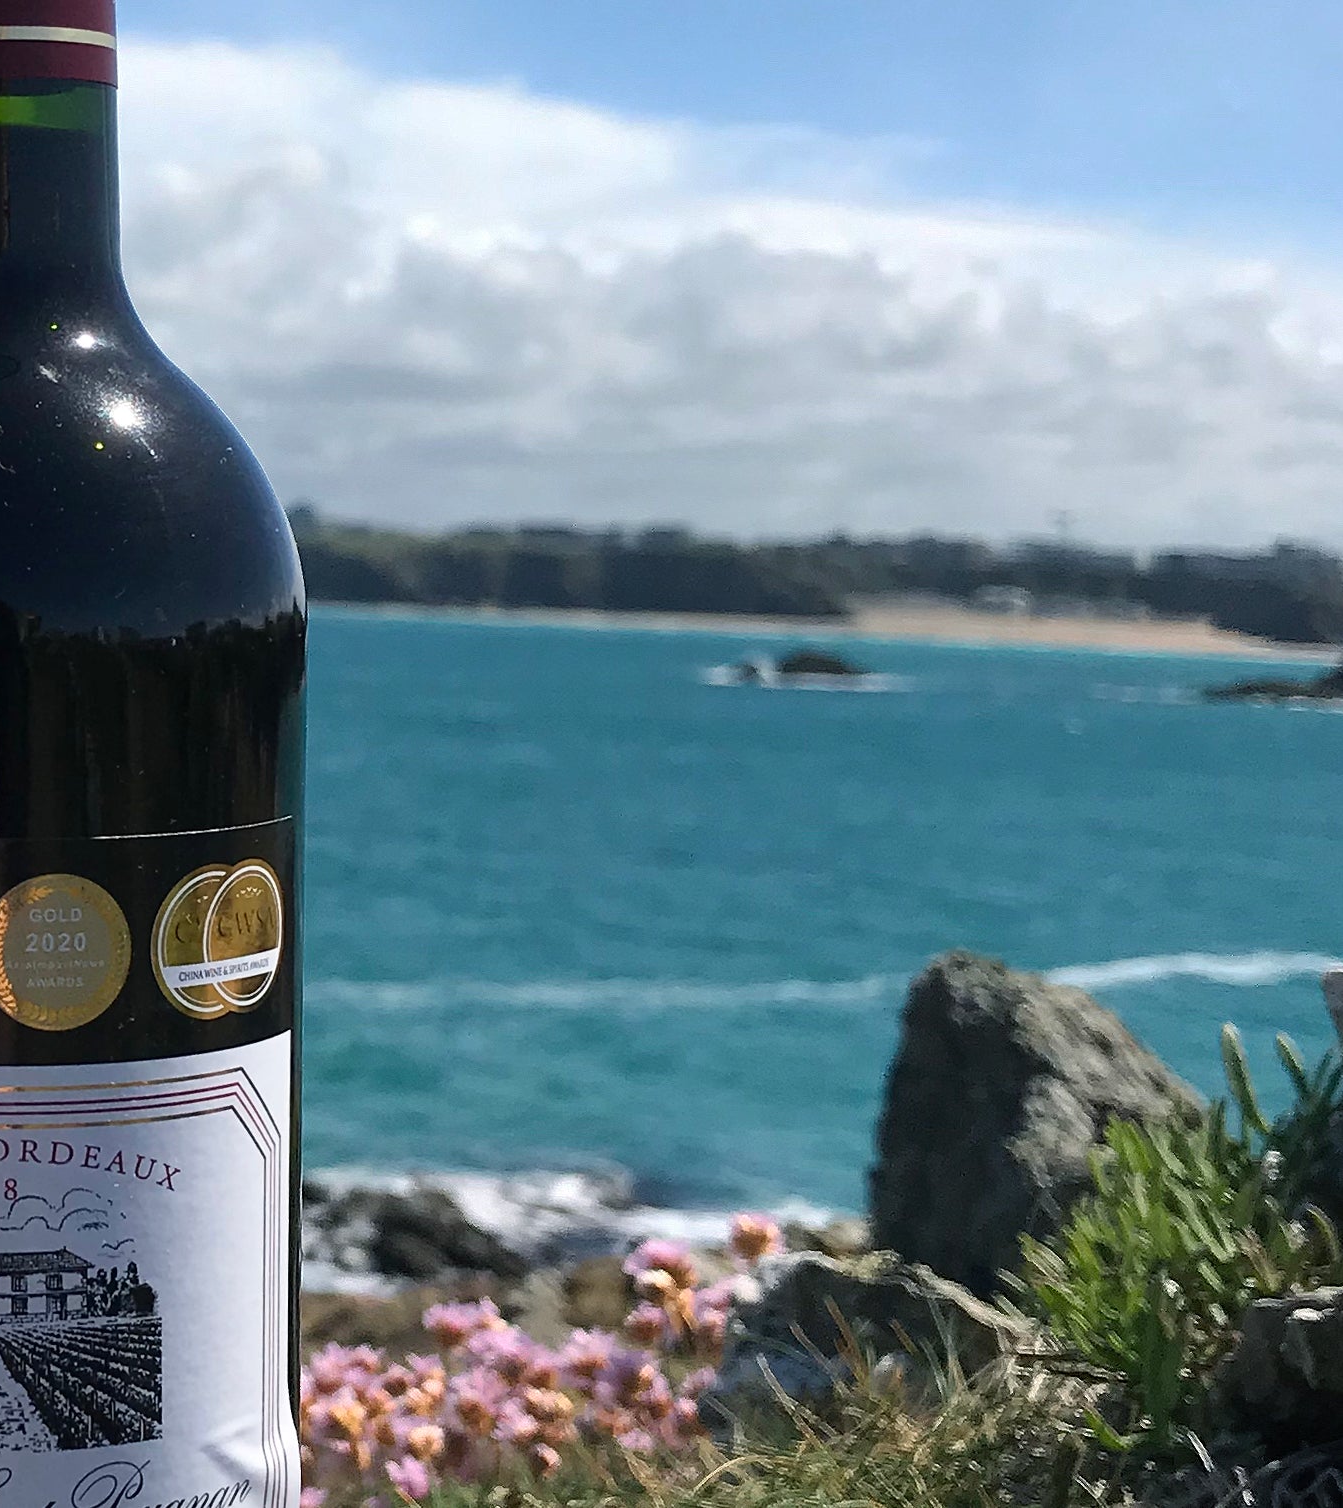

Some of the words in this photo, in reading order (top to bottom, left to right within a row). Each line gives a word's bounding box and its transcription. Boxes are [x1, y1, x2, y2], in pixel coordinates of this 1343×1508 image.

[29, 908, 82, 922] GOLD
[25, 933, 86, 952] 2020
[178, 969, 204, 982] CHINA
[204, 967, 223, 979] WINE
[27, 976, 84, 989] AWARDS
